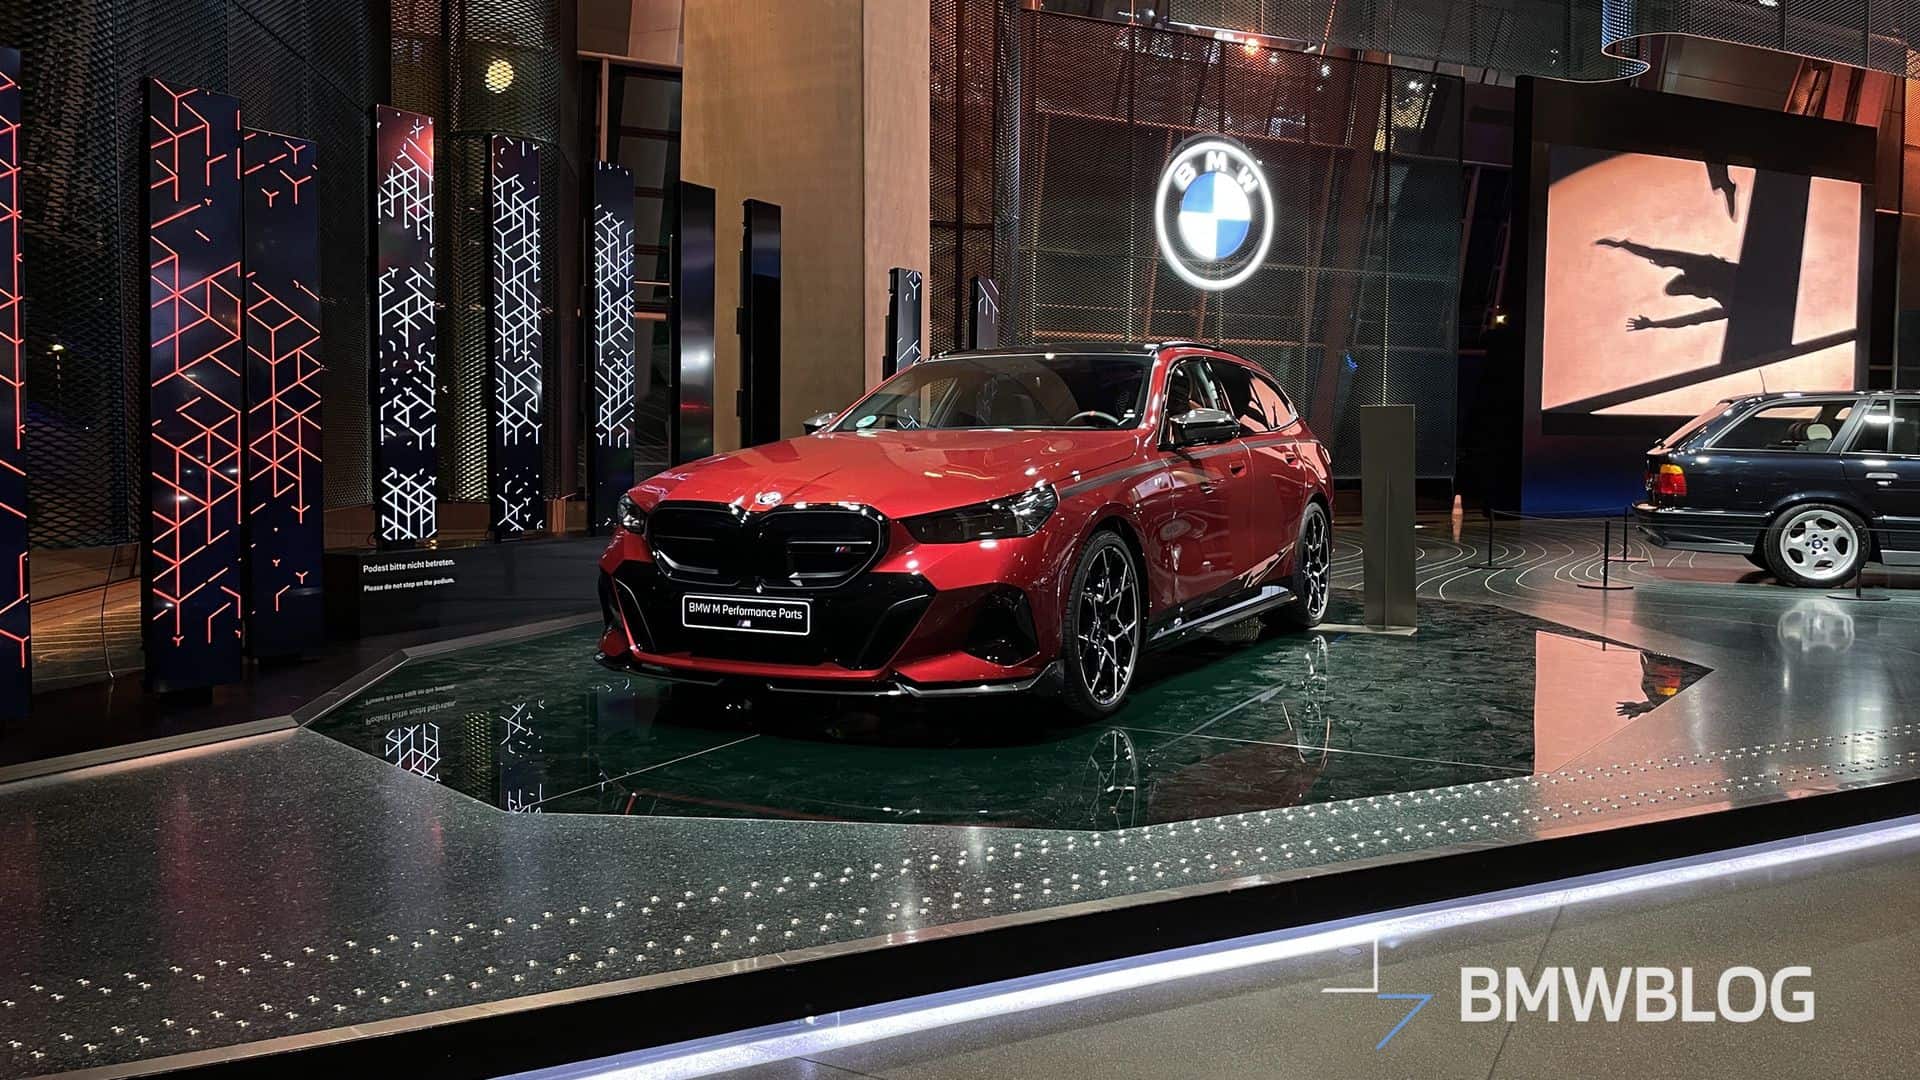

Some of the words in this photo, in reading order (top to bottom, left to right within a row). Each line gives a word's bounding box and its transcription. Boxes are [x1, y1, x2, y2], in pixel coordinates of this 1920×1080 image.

[1173, 150, 1259, 192] BMW
[363, 564, 389, 573] Podest
[390, 562, 406, 571] bitte
[407, 561, 424, 570] nicht
[425, 560, 456, 568] betreten.
[689, 602, 711, 614] BMW
[712, 604, 720, 614] M
[722, 604, 777, 618] Performance
[779, 608, 803, 620] Parts
